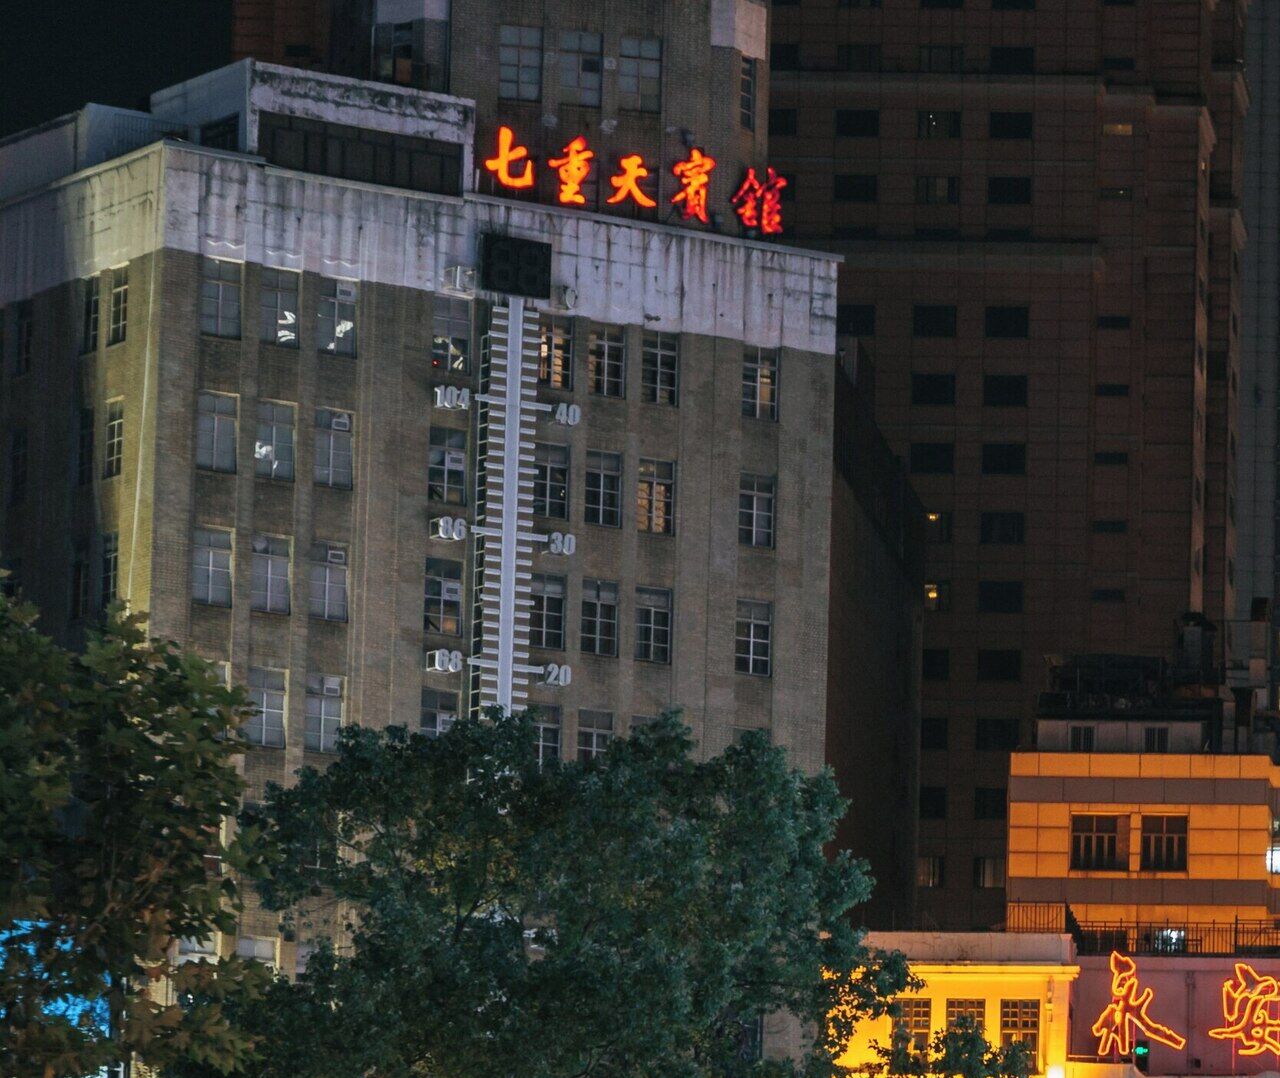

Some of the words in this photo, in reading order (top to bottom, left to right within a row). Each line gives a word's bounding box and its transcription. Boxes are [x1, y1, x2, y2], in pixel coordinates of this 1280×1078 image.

[485, 126, 787, 233] 七重天賓館
[434, 387, 470, 410] 104
[555, 403, 581, 426] 40
[438, 517, 466, 541] 86
[549, 532, 576, 555] 30
[436, 649, 463, 672] 68
[546, 663, 572, 686] 20
